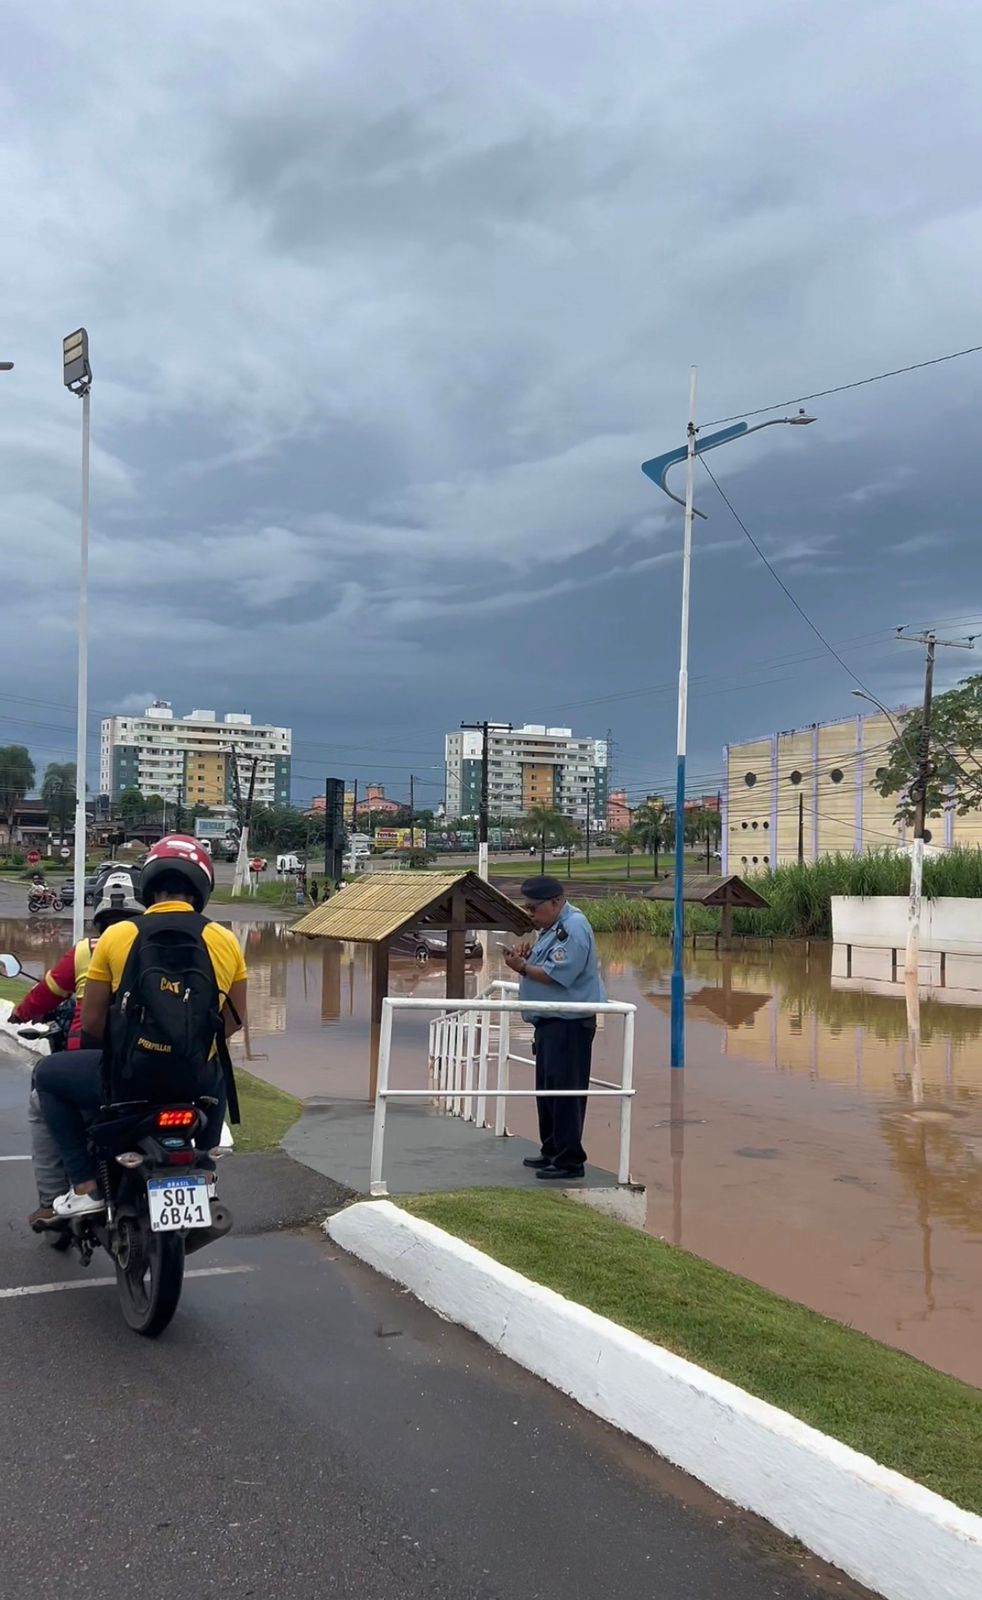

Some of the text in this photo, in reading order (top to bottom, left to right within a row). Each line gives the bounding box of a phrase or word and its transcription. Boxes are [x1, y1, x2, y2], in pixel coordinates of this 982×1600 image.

[160, 976, 181, 994] CAT
[163, 1187, 196, 1207] SQT
[160, 1205, 205, 1226] 6B41
